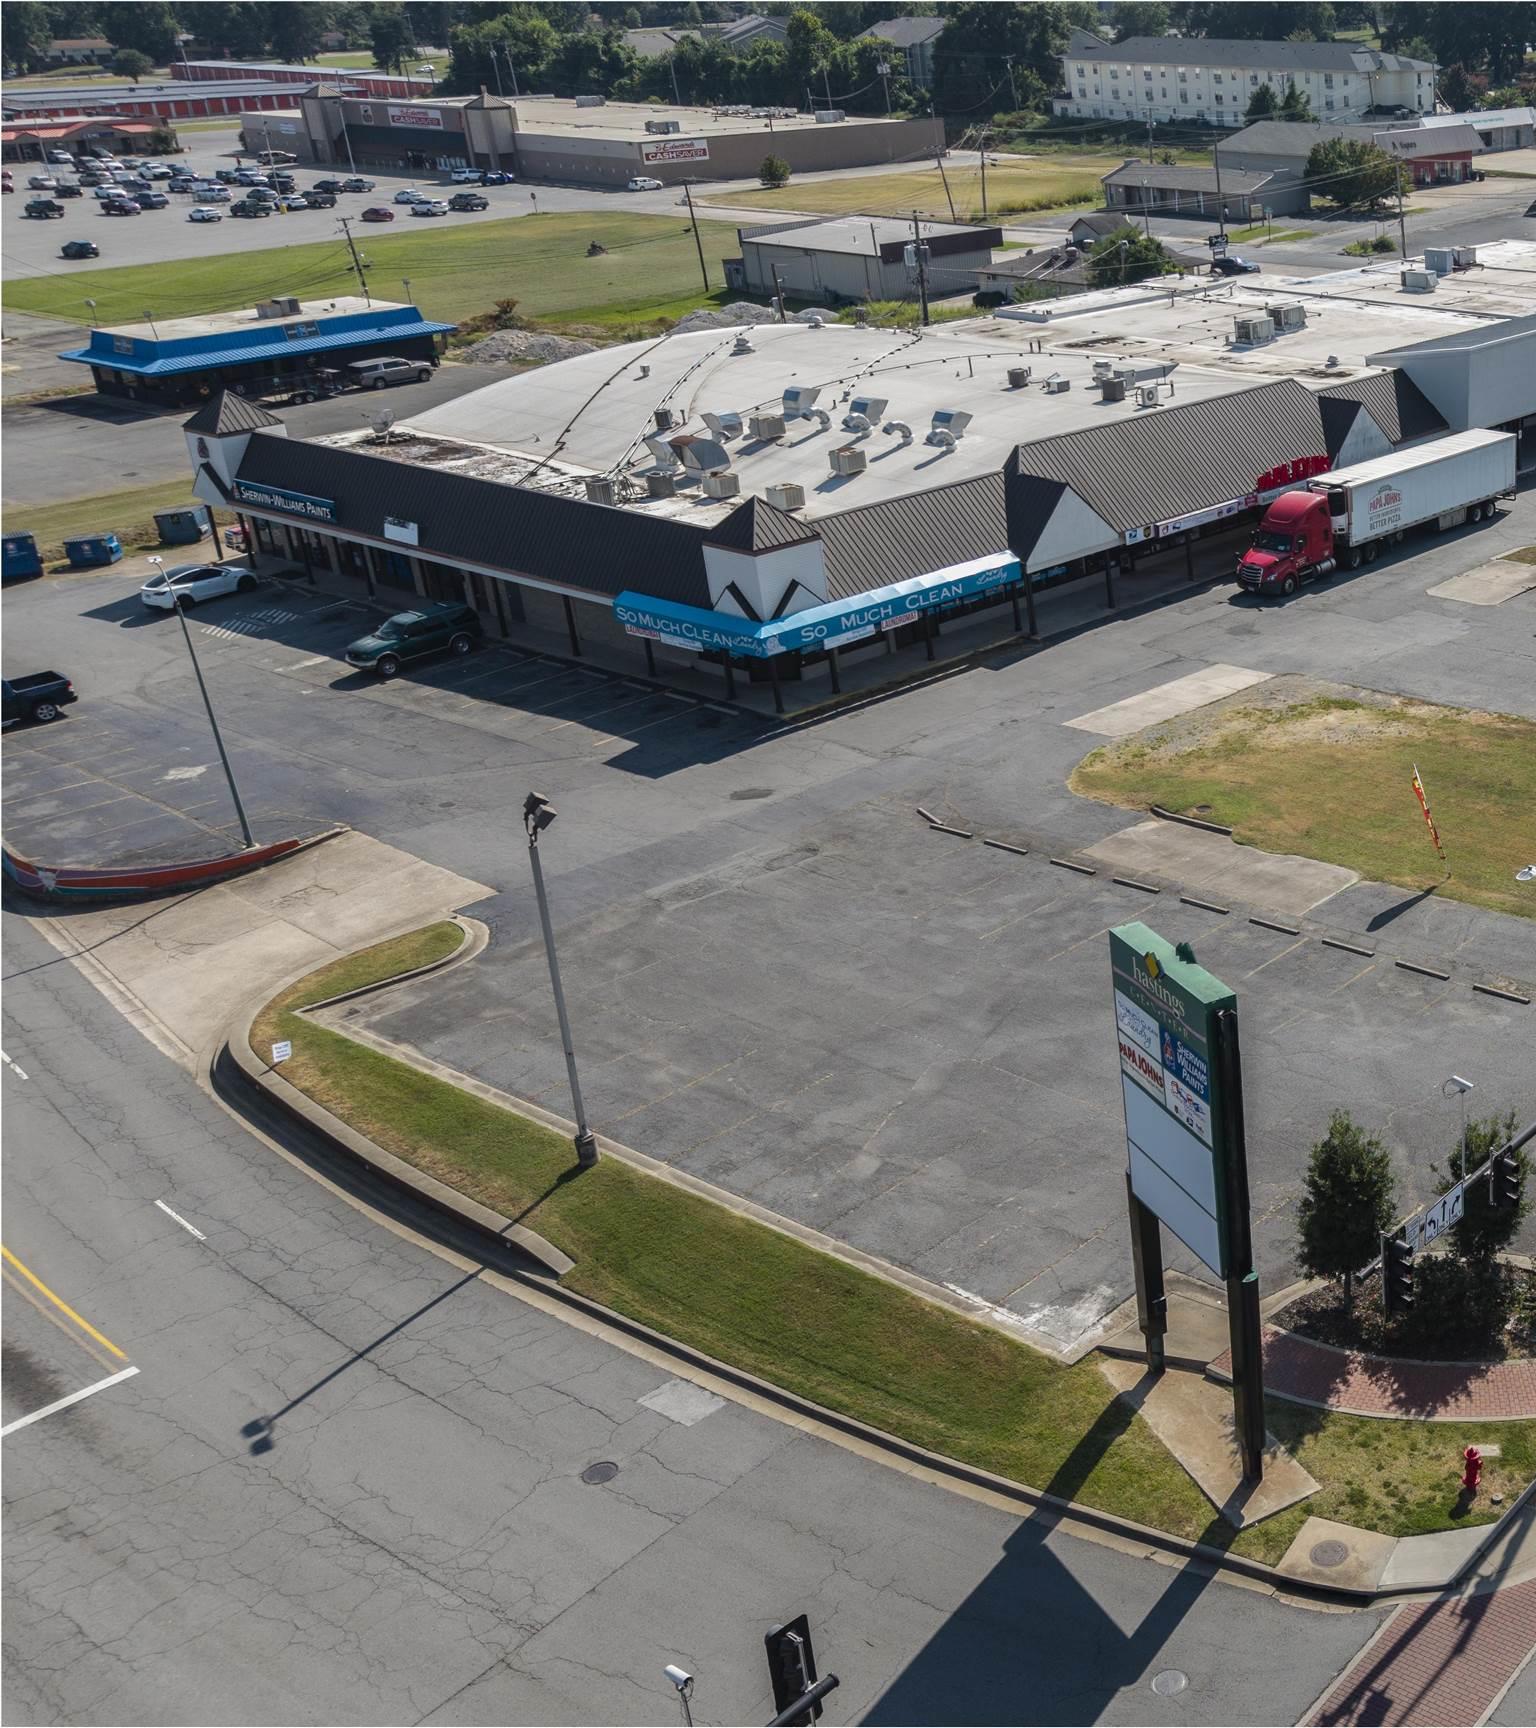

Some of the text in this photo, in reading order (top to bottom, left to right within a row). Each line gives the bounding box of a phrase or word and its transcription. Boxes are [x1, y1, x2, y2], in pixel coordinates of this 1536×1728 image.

[306, 501, 332, 519] PAINTS
[1132, 956, 1185, 1019] hastings
[1120, 1042, 1136, 1064] PAPA
[1177, 1040, 1207, 1073] SHERWIN
[1177, 1052, 1208, 1086] WILLIAMS
[1182, 1068, 1205, 1095] PAINTS
